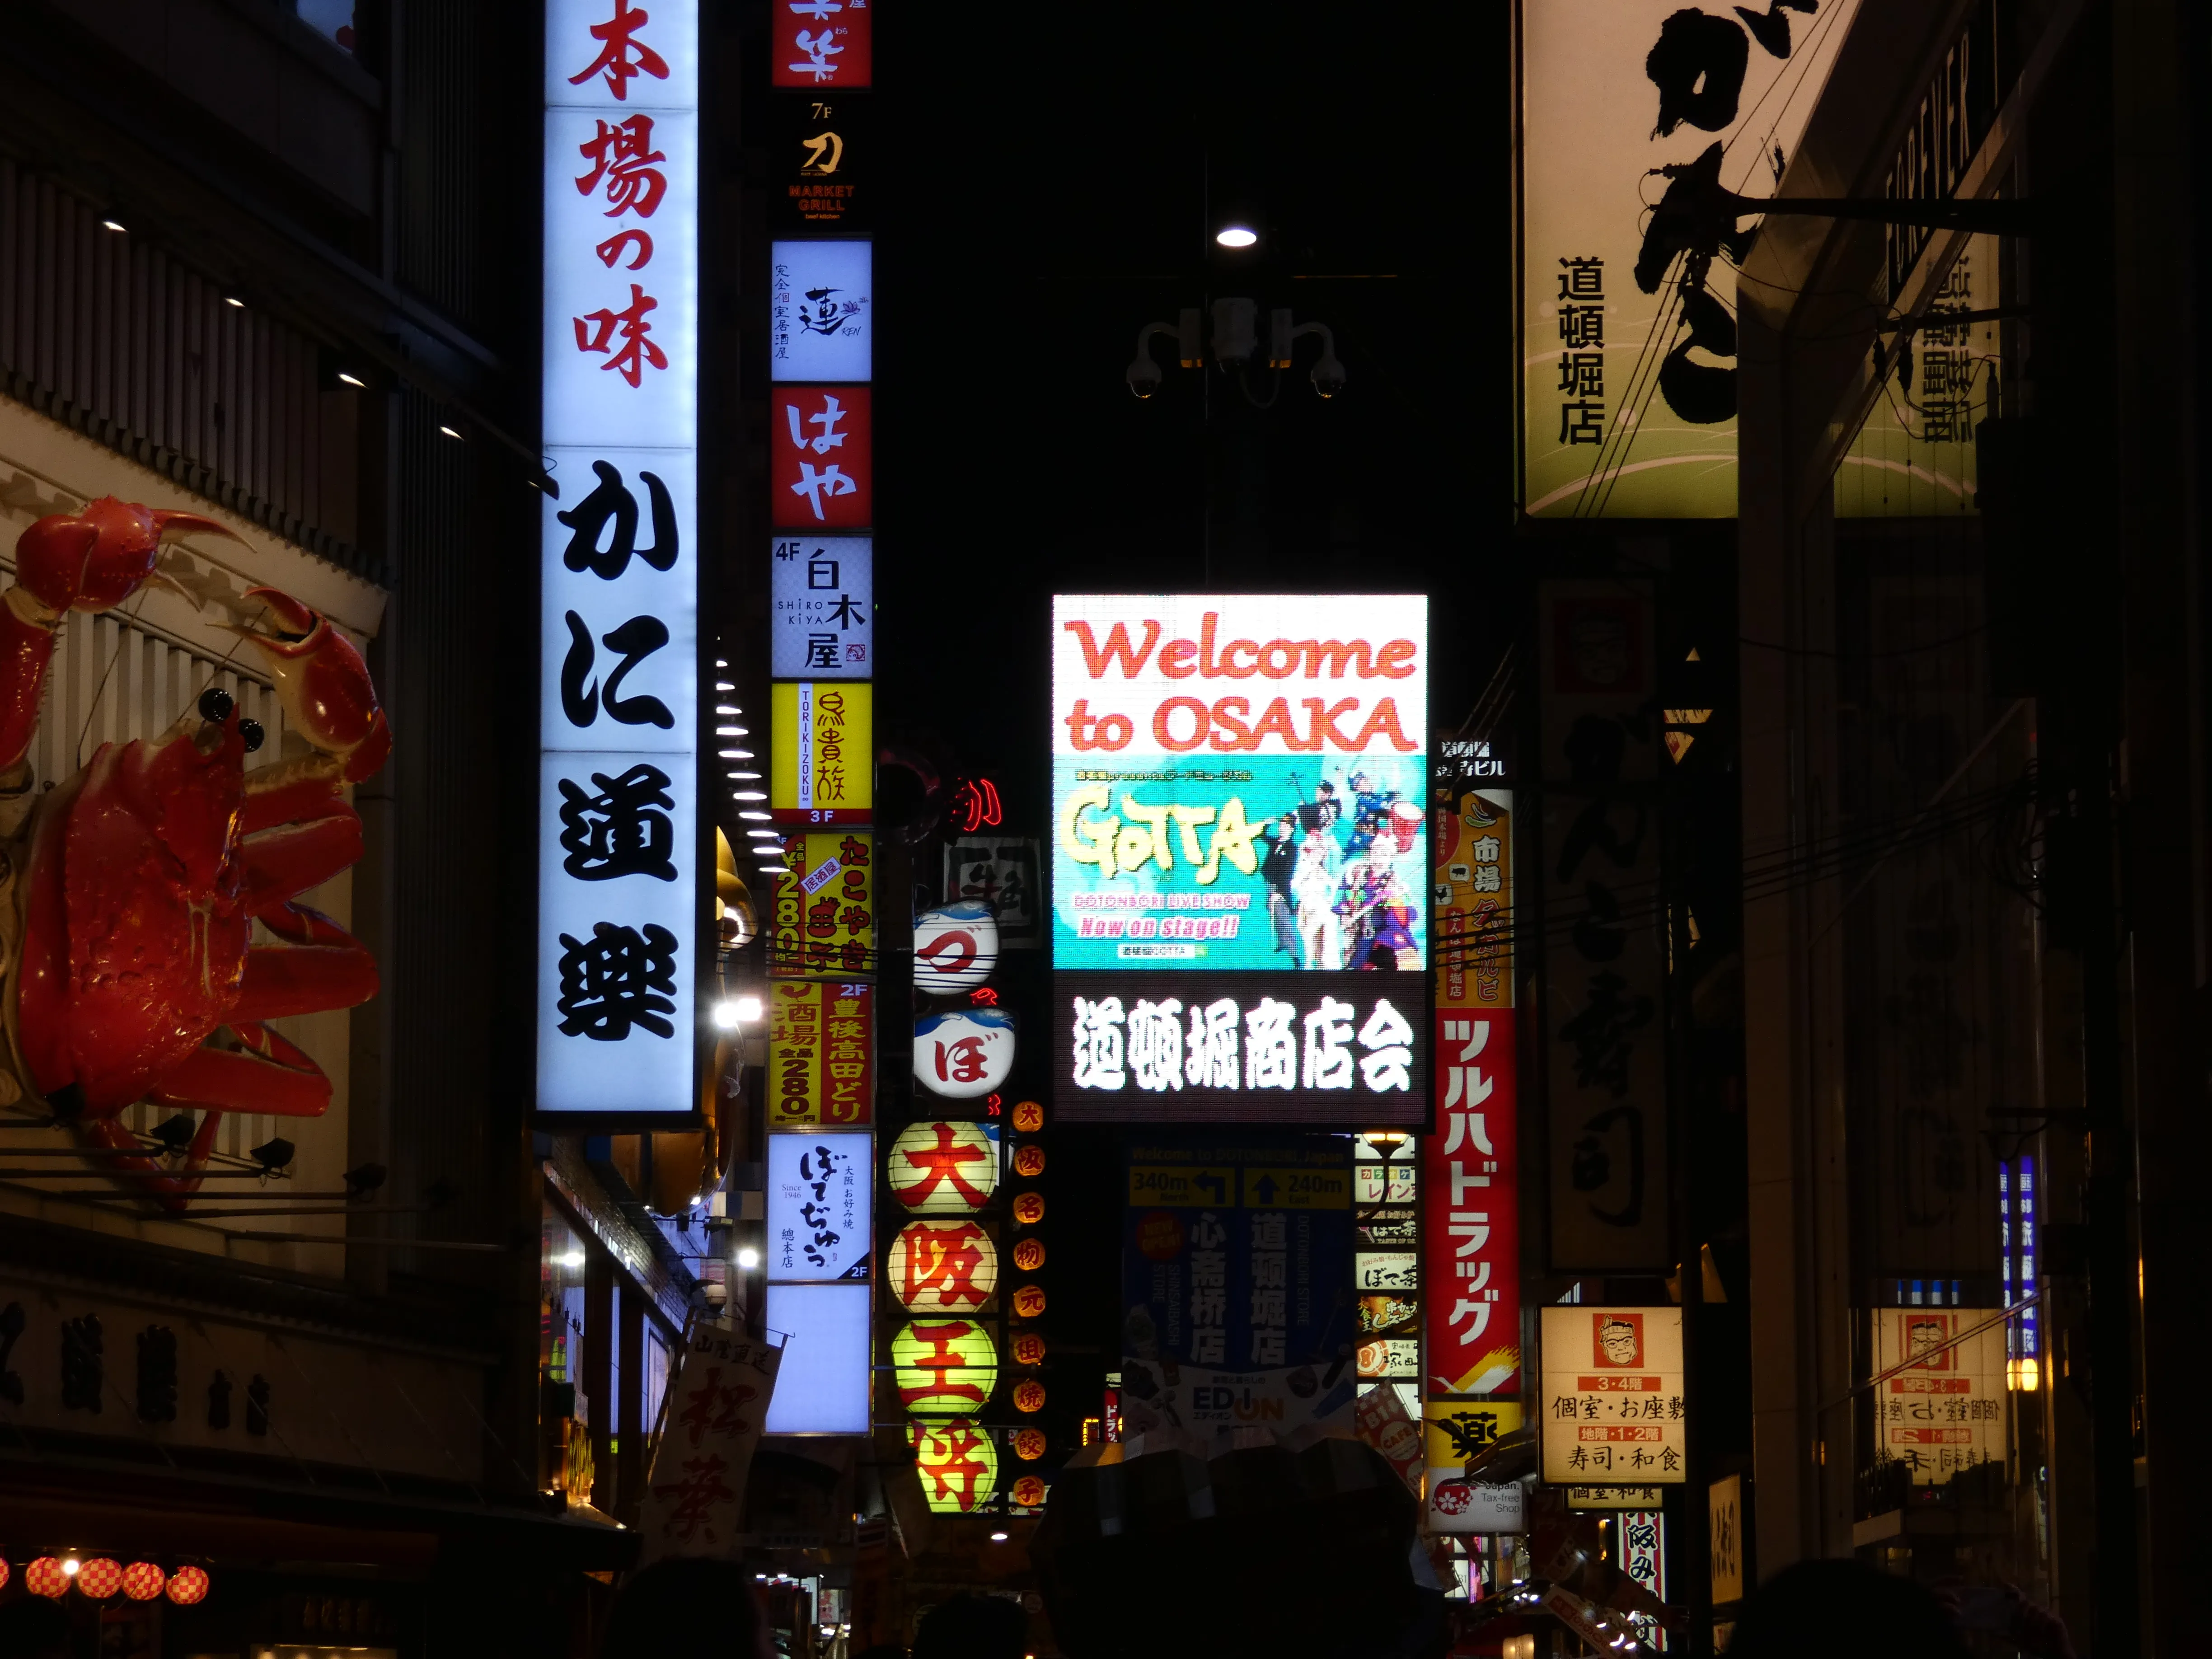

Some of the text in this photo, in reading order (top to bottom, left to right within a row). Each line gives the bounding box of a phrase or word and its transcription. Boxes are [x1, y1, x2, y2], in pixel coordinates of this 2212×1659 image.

[811, 103, 832, 119] 7F
[801, 131, 843, 173] 刀
[567, 0, 670, 389] 本場の味
[788, 185, 854, 197] MARKET
[798, 199, 845, 211] GRILL
[774, 264, 790, 359] 完全個室居酒屋
[798, 286, 847, 336] 蓮
[842, 326, 862, 337] REN
[1559, 256, 1605, 446] 道頓堀店
[787, 394, 857, 520] はや
[776, 542, 801, 561] 4F
[804, 548, 866, 668] 白木屋
[1064, 612, 1418, 680] Welcome
[1064, 696, 1420, 752] to OSAKA
[817, 692, 845, 801] 鳥貴族
[805, 861, 837, 892] 居酒屋
[1074, 895, 1249, 907] DOTONBORI LIVE SHOW
[1080, 916, 1239, 938] Now on stage!!
[841, 984, 868, 996] 2F
[771, 1002, 821, 1046] 酒場
[1073, 996, 1416, 1093] 道頓堀商店会
[781, 1059, 809, 1115] 280
[1133, 1147, 1193, 1161] Welcome
[1198, 1148, 1212, 1160] to
[1304, 1151, 1345, 1165] Japan
[844, 1166, 854, 1186] 大阪
[1134, 1172, 1188, 1191] 340m
[1289, 1175, 1343, 1193] 240m
[1362, 1169, 1411, 1180] カラオケ
[1444, 1020, 1499, 1346] ツルハドラッグ
[800, 1146, 848, 1267] ぼてぢゅう
[1144, 1220, 1174, 1236] NEW
[851, 1266, 867, 1277] 2F
[1298, 1215, 1310, 1326] DOTONBORI STORE
[893, 1122, 990, 1511] 大阪王将
[1598, 1377, 1642, 1391] 3・4階
[1194, 1387, 1284, 1420] EDION
[1552, 1395, 1684, 1420] 個室・お座敷
[1106, 1405, 1117, 1442] ドラッ
[1582, 1427, 1659, 1440] 地階・1・2階
[1567, 1445, 1680, 1471] 寿司・和食
[1481, 1493, 1520, 1502] Tax-free
[1496, 1504, 1520, 1514] Shop
